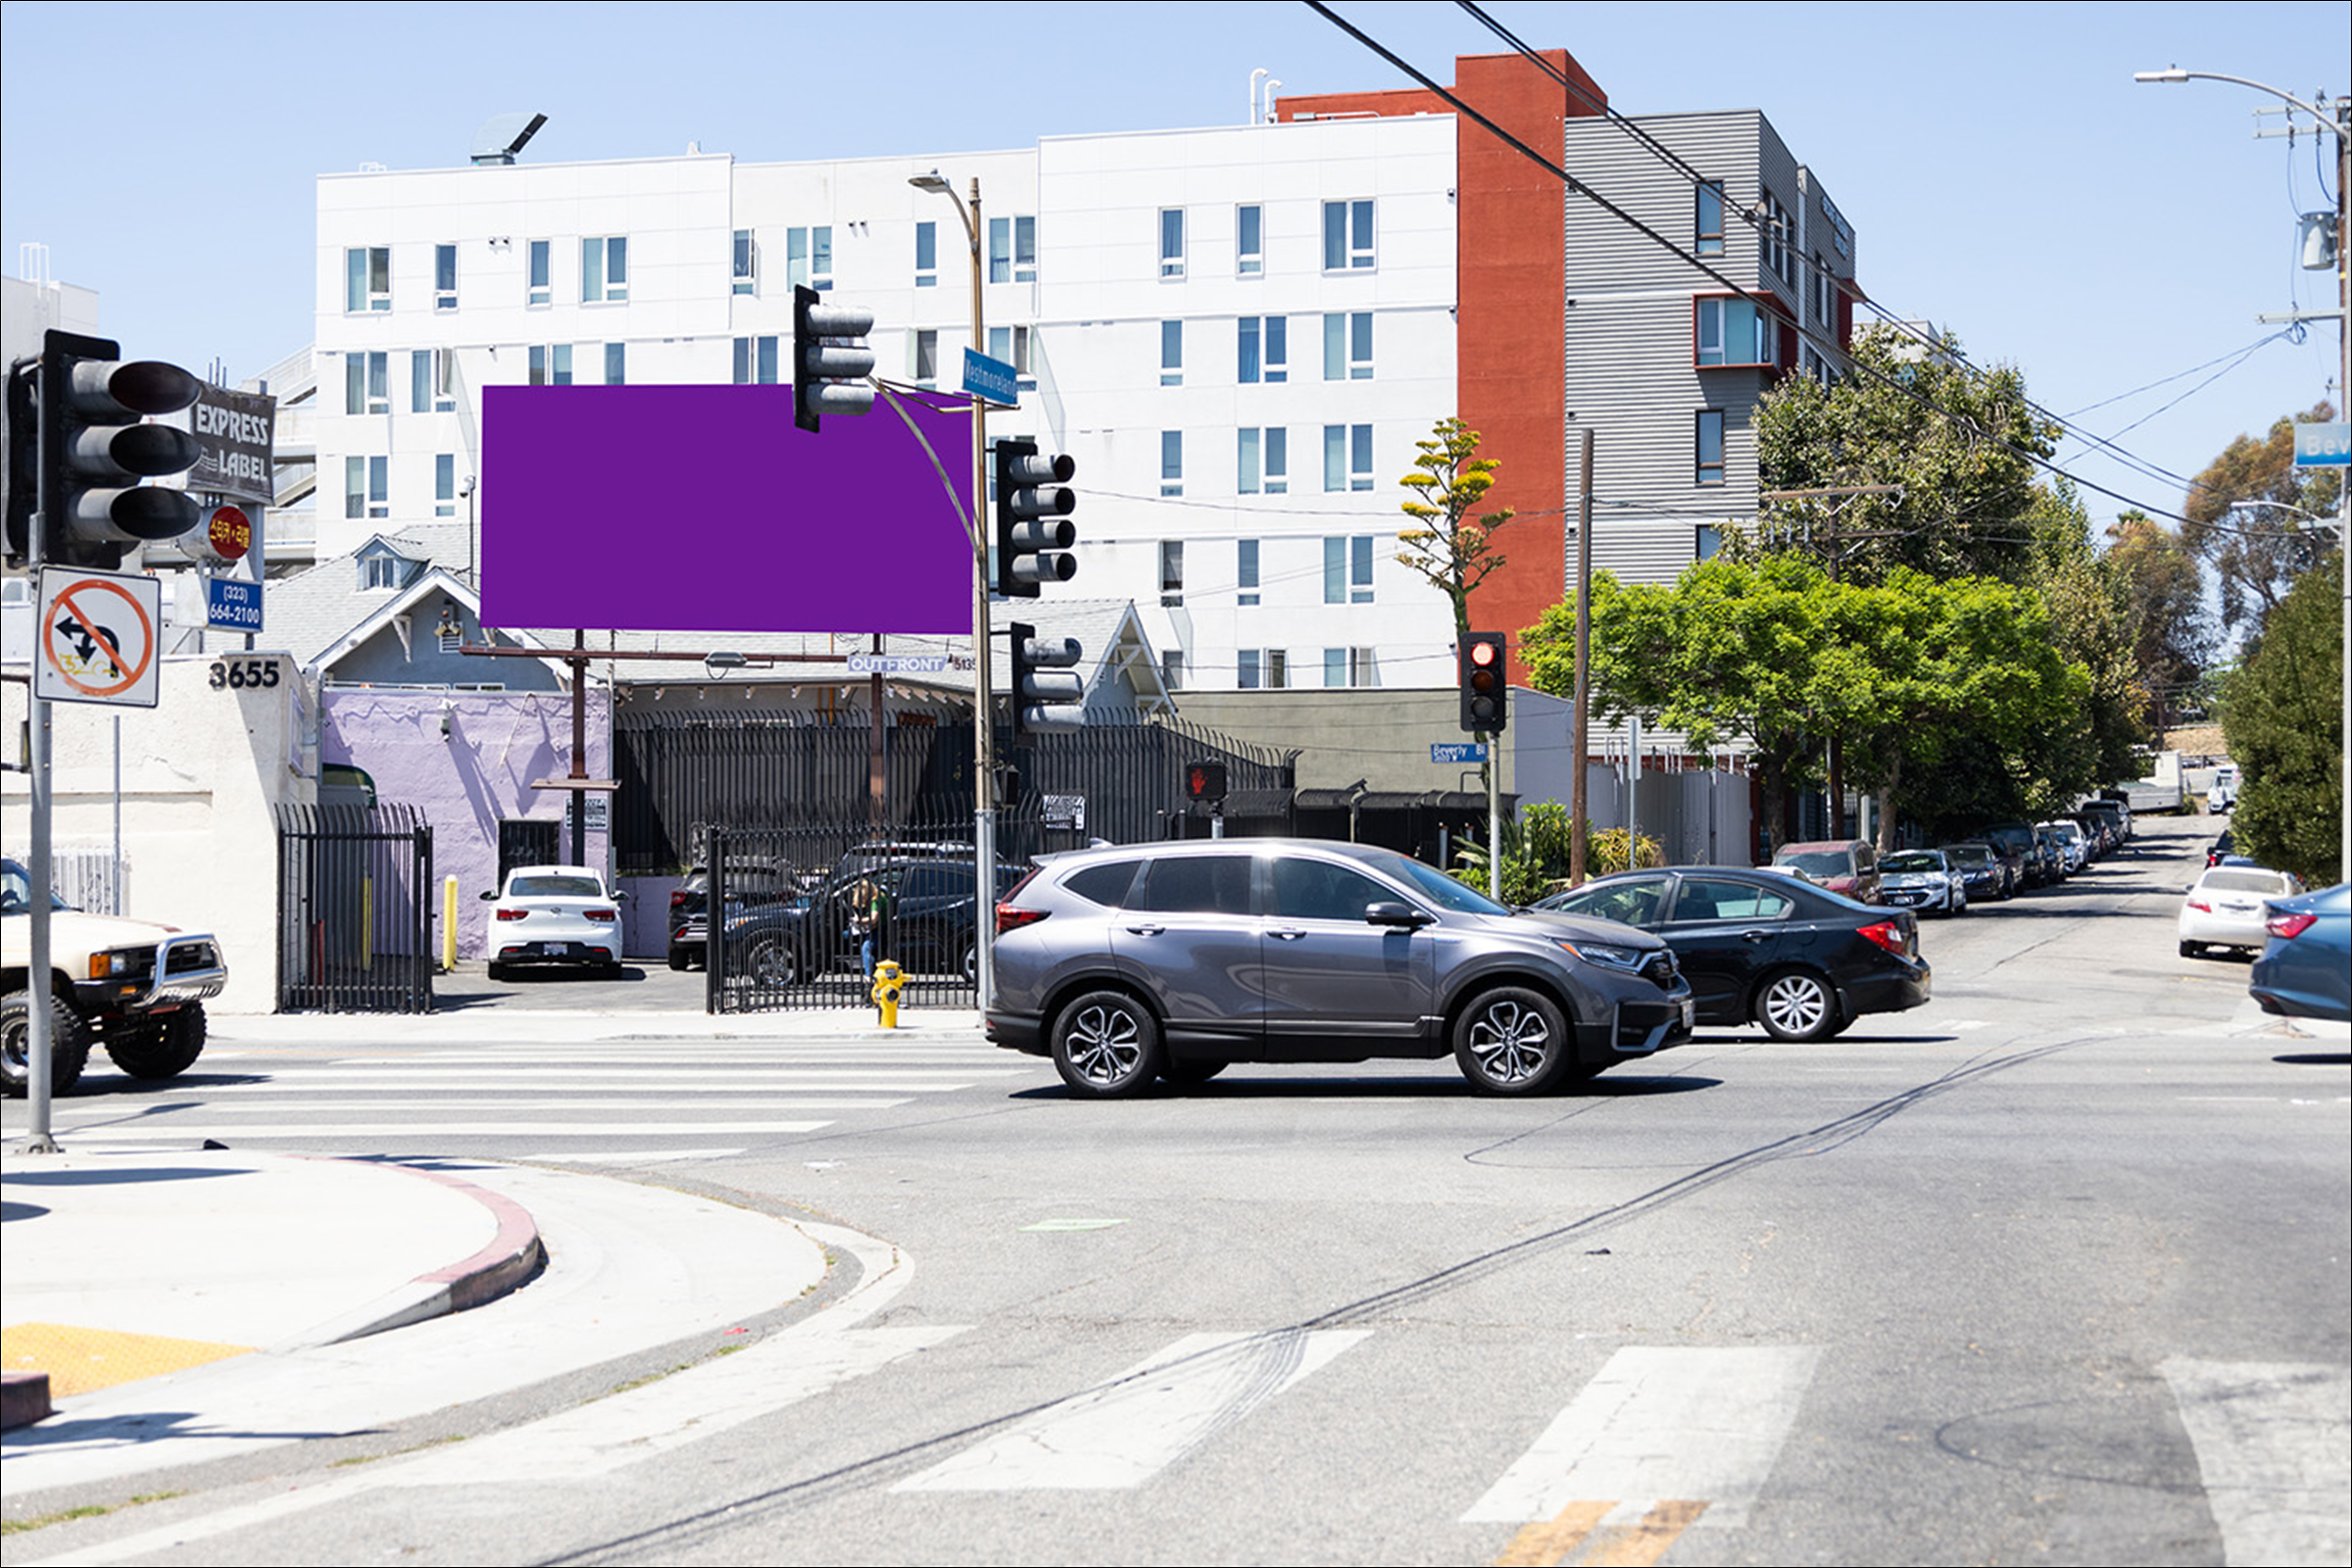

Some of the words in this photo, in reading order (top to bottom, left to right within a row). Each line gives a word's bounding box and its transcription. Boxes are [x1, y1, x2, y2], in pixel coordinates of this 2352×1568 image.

[197, 403, 269, 446] EXPRESS
[2306, 435, 2350, 456] Bev
[219, 449, 268, 481] LABEL
[223, 585, 248, 605] (323)
[210, 603, 260, 624] 664-2100
[851, 658, 944, 671] OUTFRONT
[208, 661, 280, 690] 3655
[1433, 744, 1467, 758] Beverly
